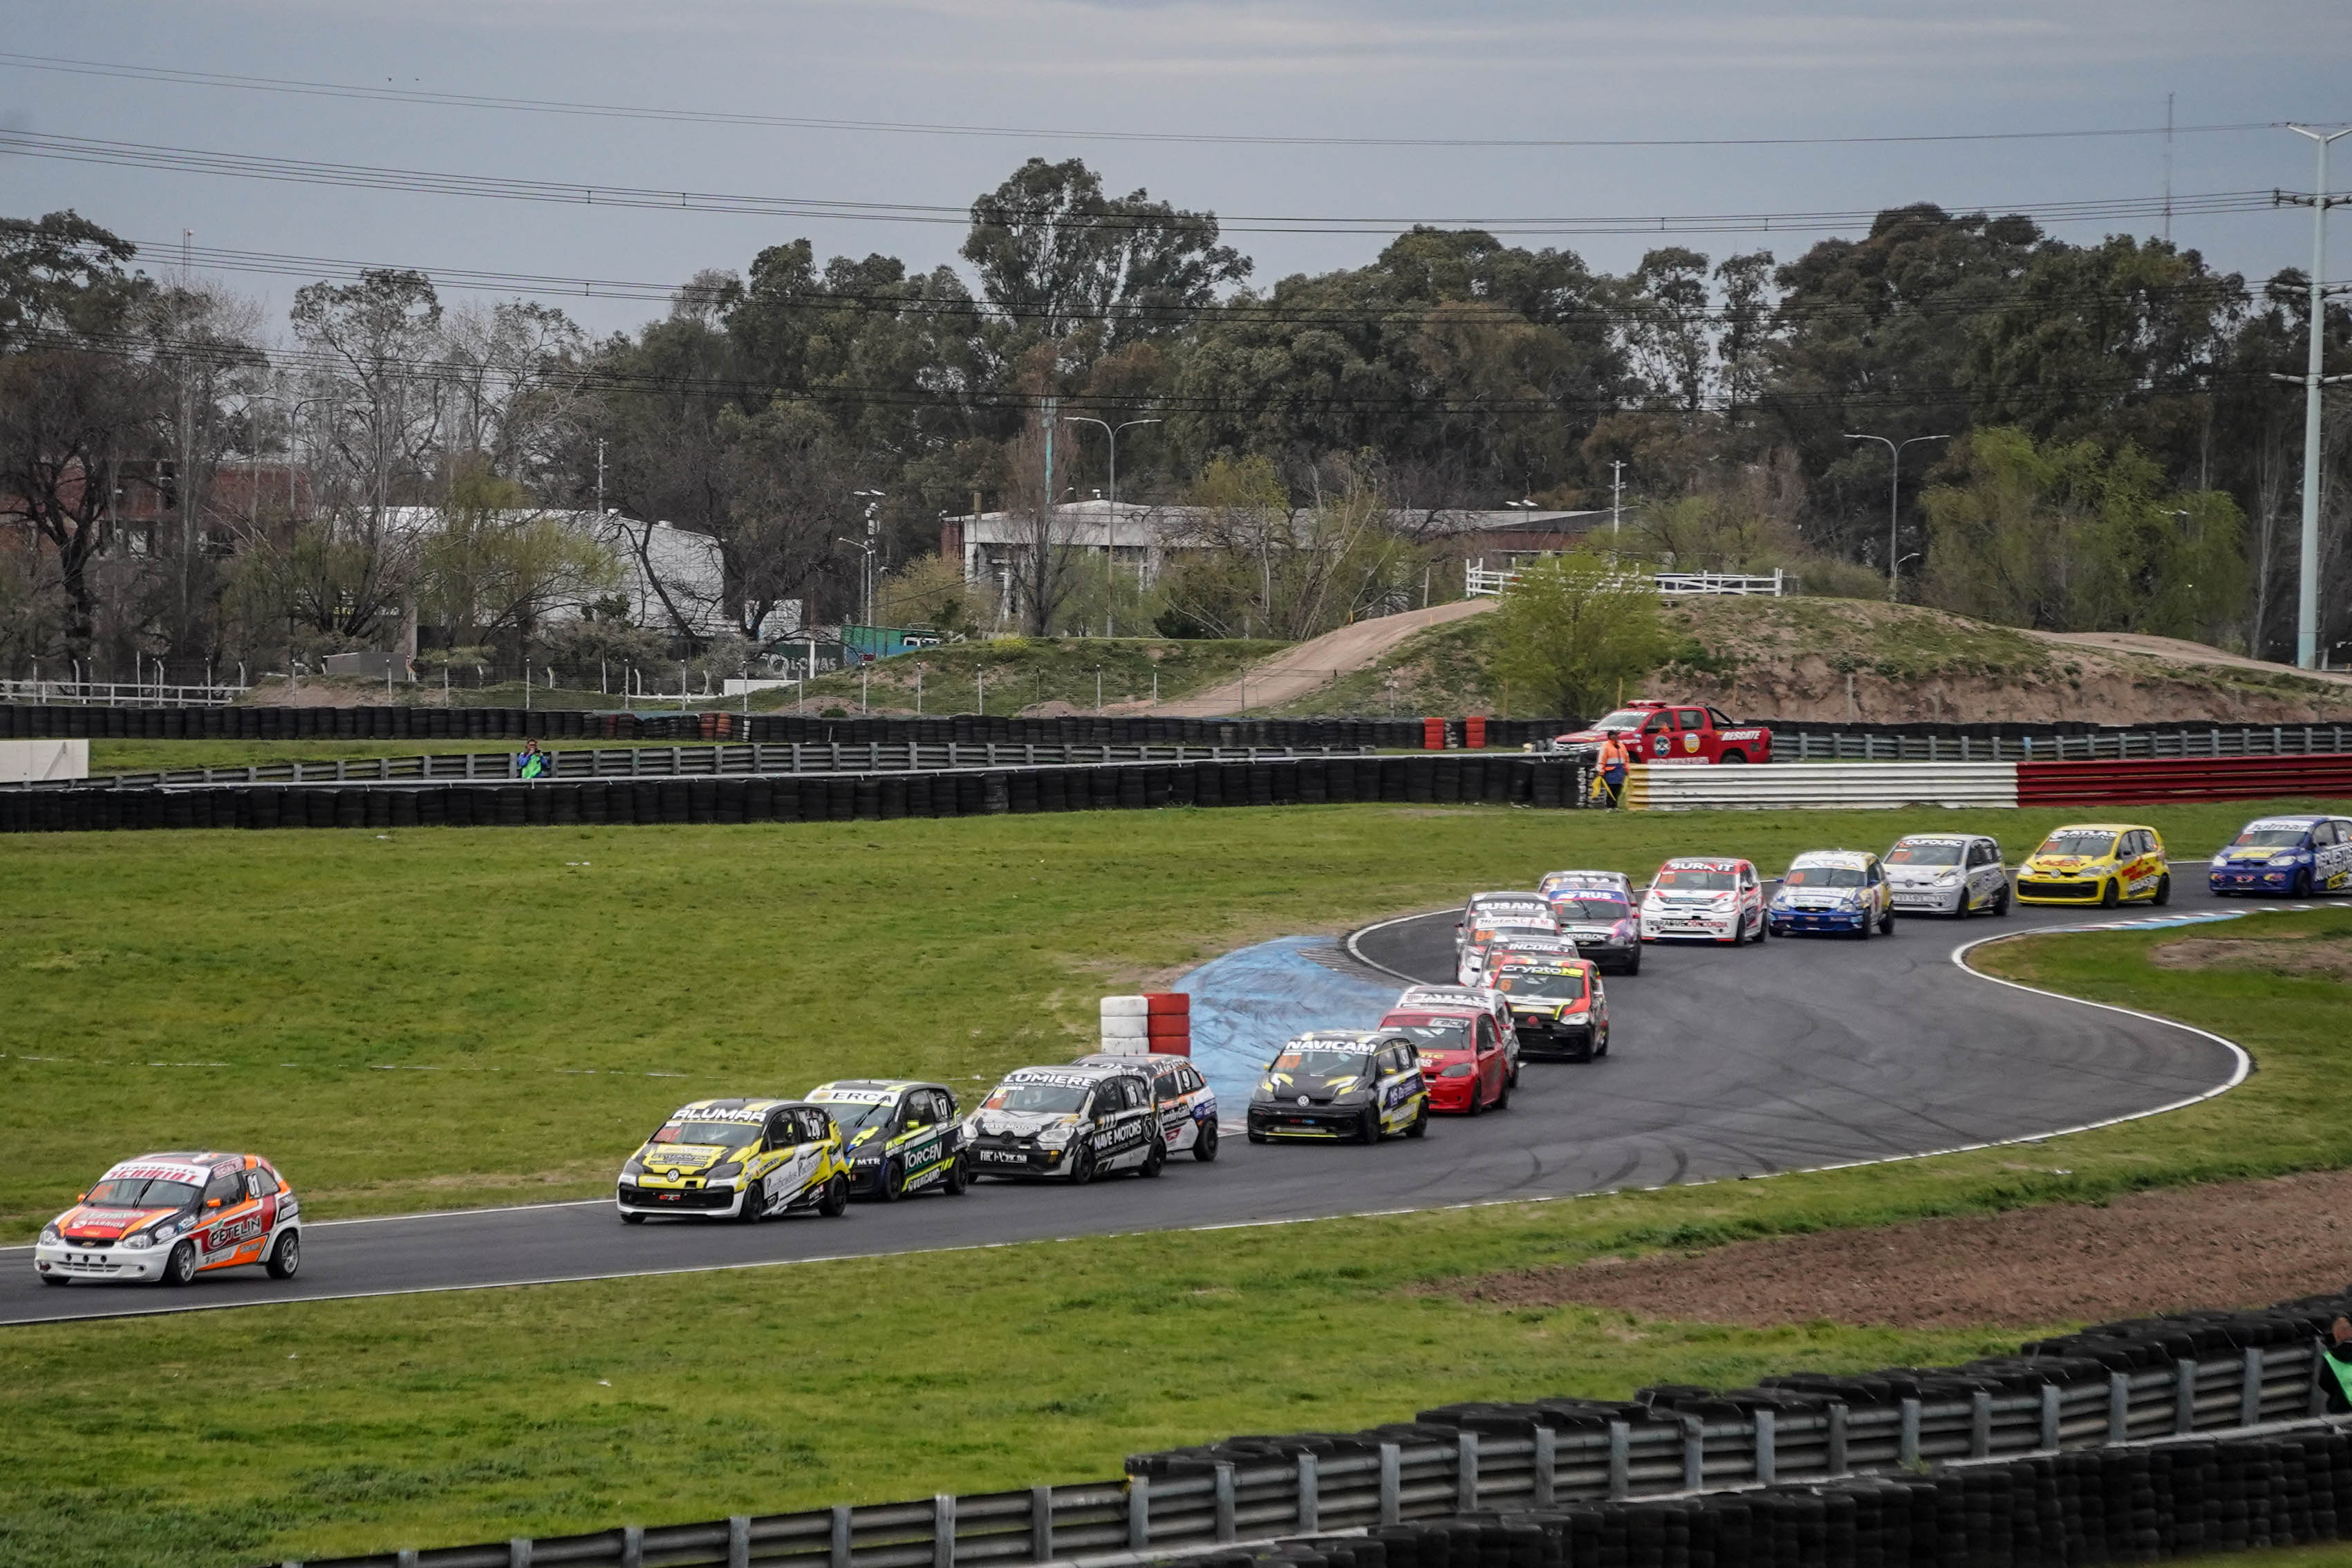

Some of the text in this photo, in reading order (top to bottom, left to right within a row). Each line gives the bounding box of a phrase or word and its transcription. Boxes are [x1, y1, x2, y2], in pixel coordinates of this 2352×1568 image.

[1721, 730, 1762, 742] RESCATE
[1905, 839, 1963, 847] DUFOURC
[1578, 891, 1612, 899] RUS
[1475, 902, 1547, 911] SUSANA
[1500, 978, 1512, 991] 6
[1286, 1040, 1376, 1053] NAVICAM
[1004, 1074, 1096, 1088] LUMIERE
[1182, 1070, 1191, 1088] 9
[832, 1092, 892, 1103] ERCA
[937, 1097, 949, 1119] 17
[671, 1108, 767, 1123] ALUMAR
[1006, 1123, 1043, 1132] MOTORS
[1094, 1130, 1113, 1151] NAVE
[1113, 1119, 1142, 1144] MOTORS
[857, 1157, 881, 1166] MTR
[903, 1141, 942, 1170] TORCEN
[87, 1220, 126, 1229] BARRIOS
[211, 1215, 261, 1244] PETELIN
